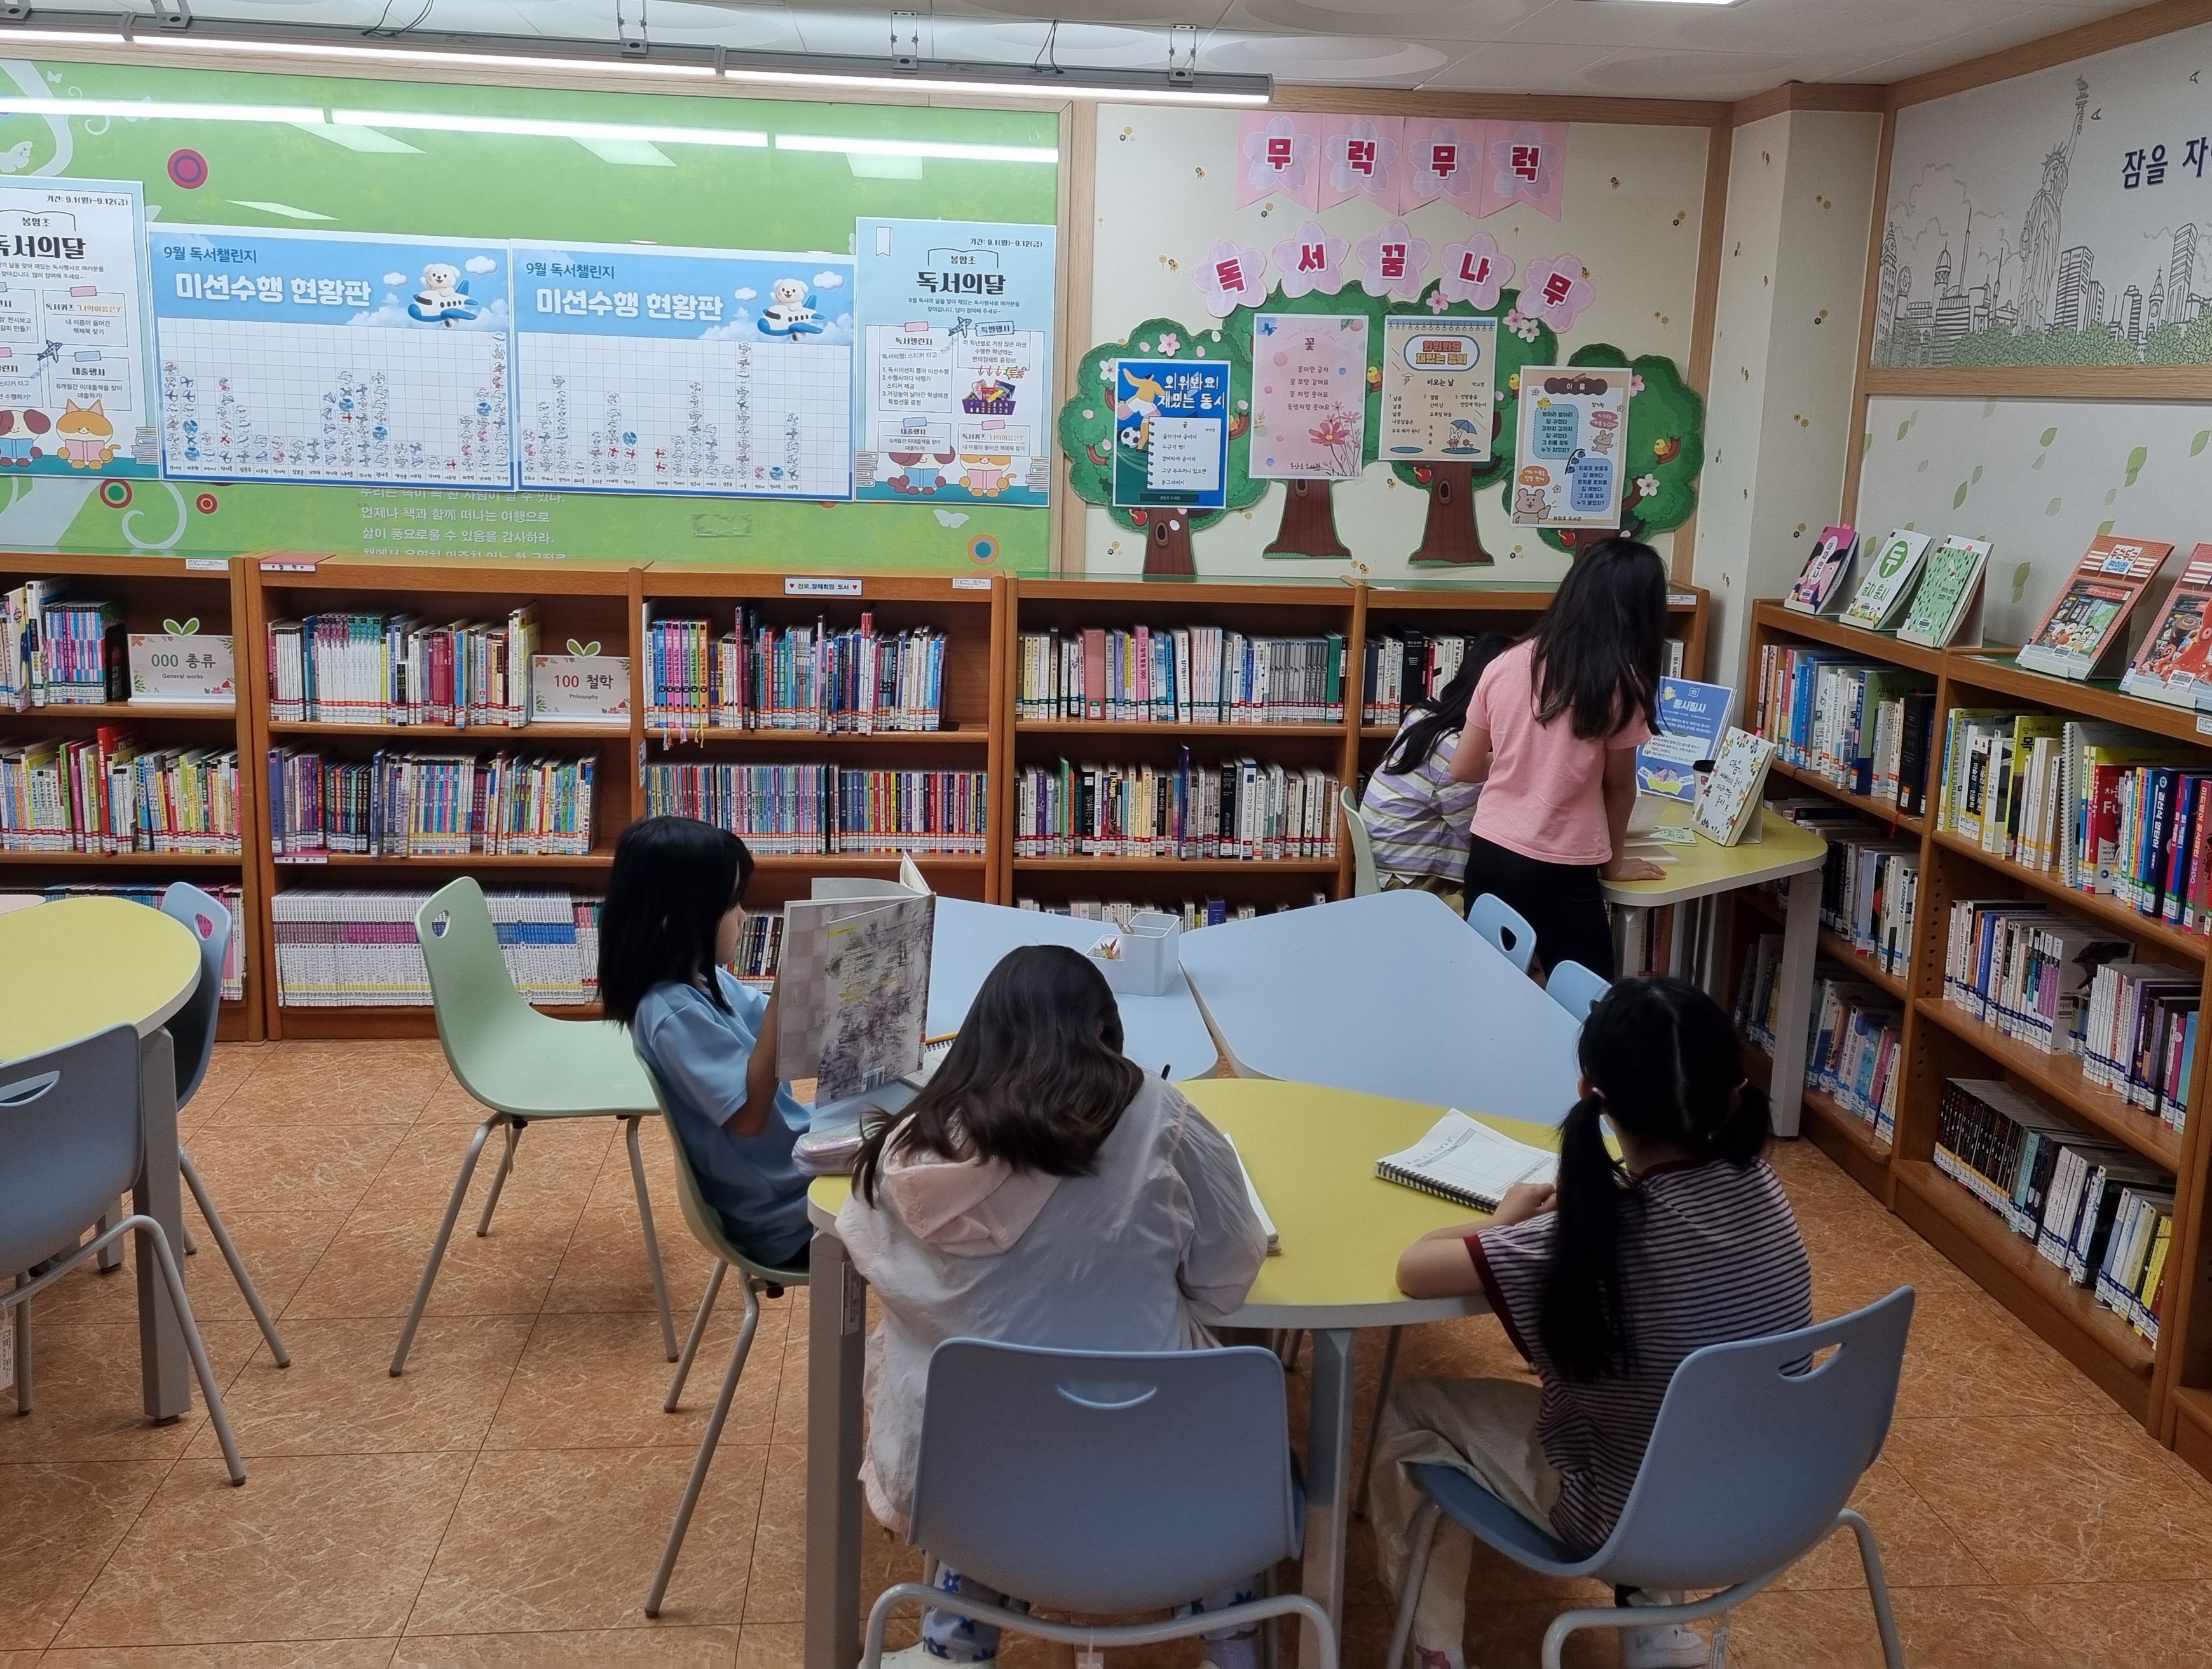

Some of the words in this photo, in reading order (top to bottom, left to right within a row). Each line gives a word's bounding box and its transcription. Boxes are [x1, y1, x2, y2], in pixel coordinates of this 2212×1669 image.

[1267, 138, 1540, 182] 무럭무럭
[2122, 144, 2168, 189] 잠을
[2182, 136, 2212, 178] 자
[46, 195, 64, 203] 기간:
[22, 217, 51, 227] 봉암초
[970, 238, 986, 246] 기간:
[163, 246, 186, 261] 9월
[189, 247, 257, 264] 독서챌린지
[950, 256, 976, 264] 봉암초
[526, 262, 547, 277] 9월
[550, 263, 615, 280] 독서챌린지
[916, 271, 1007, 295] 독서의달
[290, 277, 372, 306] 현황판
[46, 303, 75, 311] 독서퀴즈
[646, 292, 724, 321] 현황판
[1305, 338, 1314, 351] 꽃
[1164, 372, 1219, 390] 외워봐요!
[1448, 378, 1454, 387] 날
[1200, 392, 1225, 409] 동시
[362, 507, 399, 519] 언제나
[404, 507, 428, 520] 책과
[432, 508, 456, 521] 함께
[461, 510, 497, 522] 떠나는
[502, 511, 550, 523] 여행으로
[363, 528, 387, 540] 삶이
[392, 528, 440, 542] 풍요로울
[446, 530, 458, 542] 수
[461, 530, 498, 543] 있음을
[503, 532, 554, 544] 감사하라.
[151, 654, 179, 667] 000
[185, 653, 216, 669] 총류
[554, 675, 580, 688] 100
[586, 674, 614, 690] 철학
[1672, 699, 1707, 713] 동시필사
